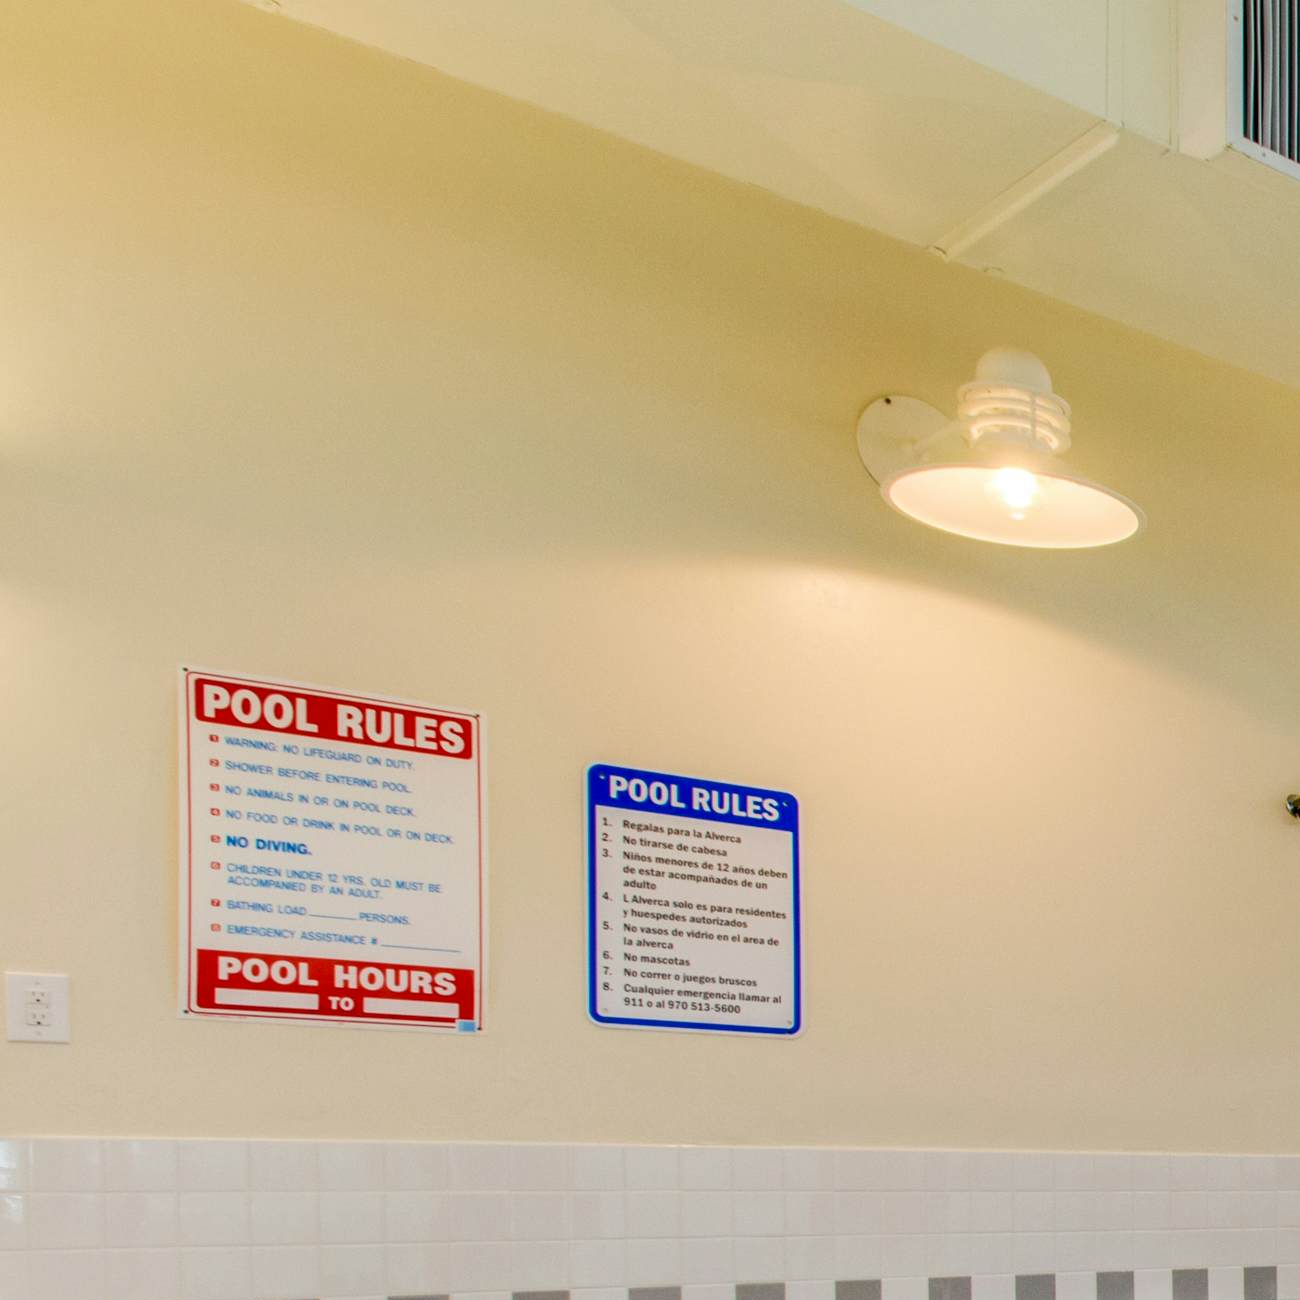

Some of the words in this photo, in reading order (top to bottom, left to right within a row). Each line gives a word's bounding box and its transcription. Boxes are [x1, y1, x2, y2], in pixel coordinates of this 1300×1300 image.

[203, 683, 319, 734] POOL
[337, 703, 466, 755] RULES
[283, 744, 299, 755] NO
[303, 747, 361, 763] LIFEGUARD
[366, 755, 381, 766] ON
[225, 760, 273, 774] SHOWER
[278, 767, 320, 781] BEFORE
[326, 773, 377, 789] ENTERING
[225, 785, 241, 796] NO
[247, 788, 293, 802] ANIMALS
[299, 794, 309, 803] IN
[313, 796, 328, 806] OR
[334, 798, 349, 808] ON
[352, 801, 381, 813] POOL
[609, 774, 687, 809] POOL
[692, 787, 780, 821] RULES
[225, 809, 241, 820] NO
[247, 812, 278, 824] FOOD
[283, 815, 298, 826] OR
[303, 818, 335, 831] DRINK
[339, 823, 349, 832] IN
[354, 824, 382, 836] POOL
[386, 828, 401, 838] OR
[406, 830, 421, 840] ON
[602, 817, 612, 827] 1.
[623, 820, 664, 833] Regalas
[667, 827, 691, 838] para
[693, 829, 702, 839] la
[705, 831, 742, 844] Alverca
[226, 835, 248, 848] NO
[255, 838, 312, 855] DIVING.
[602, 832, 612, 842] 2.
[623, 835, 637, 846] No
[640, 838, 674, 850] tirarse
[676, 843, 689, 852] de
[691, 846, 728, 857] cabesa
[602, 848, 612, 858] 3.
[623, 851, 652, 863] Niños
[655, 857, 699, 869] menores
[701, 861, 714, 871] de
[717, 863, 730, 872] 12
[732, 865, 756, 876] años
[758, 868, 788, 879] deben
[226, 863, 281, 877] CHILDREN
[286, 869, 322, 881] UNDER
[328, 873, 337, 883] 12
[370, 877, 391, 888] OLD
[395, 880, 424, 891] MUST
[428, 883, 442, 893] BE
[228, 876, 306, 892] ACCOMPANIED
[311, 883, 323, 893] BY
[329, 886, 343, 895] AN
[623, 865, 636, 874] de
[638, 868, 666, 878] estar
[668, 871, 738, 886] acompañados
[741, 879, 753, 888] de
[755, 882, 768, 890] un
[623, 880, 657, 890] adulto
[226, 900, 273, 913] BATHING
[278, 904, 307, 916] LOAD
[602, 891, 612, 901] 4.
[632, 894, 670, 907] Alverca
[673, 901, 693, 910] solo
[696, 903, 708, 911] es
[710, 904, 733, 914] para
[735, 907, 786, 919] residentes
[623, 909, 628, 918] y
[631, 909, 687, 922] huespedes
[689, 916, 748, 928] autorizados
[227, 924, 295, 938] EMERGENCY
[301, 931, 366, 945] ASSISTANCE
[602, 921, 613, 931] 5.
[624, 923, 637, 933] No
[640, 927, 669, 936] vasos
[671, 928, 684, 937] de
[687, 930, 714, 940] vidrio
[717, 934, 729, 942] en
[731, 934, 740, 943] el
[743, 936, 765, 945] area
[767, 937, 779, 946] de
[623, 937, 633, 946] la
[636, 939, 674, 950] alverca
[602, 950, 613, 960] 6.
[624, 952, 637, 962] No
[640, 955, 690, 966] mascotas
[217, 956, 319, 986] POOL
[334, 964, 457, 996] HOURS
[602, 966, 612, 976] 7.
[624, 968, 637, 977] No
[640, 971, 671, 981] correr
[682, 973, 716, 985] juegos
[719, 976, 757, 987] bruscos
[328, 996, 355, 1011] TO
[602, 982, 613, 991] 8.
[624, 983, 674, 996] Cualquier
[677, 989, 736, 1001] emergencia
[739, 993, 770, 1003] llamar
[772, 995, 782, 1004] al
[624, 997, 643, 1007] 911
[647, 1000, 653, 1008] o
[655, 1000, 665, 1009] al
[668, 1000, 688, 1010] 970
[691, 1002, 741, 1014] 513-5600
